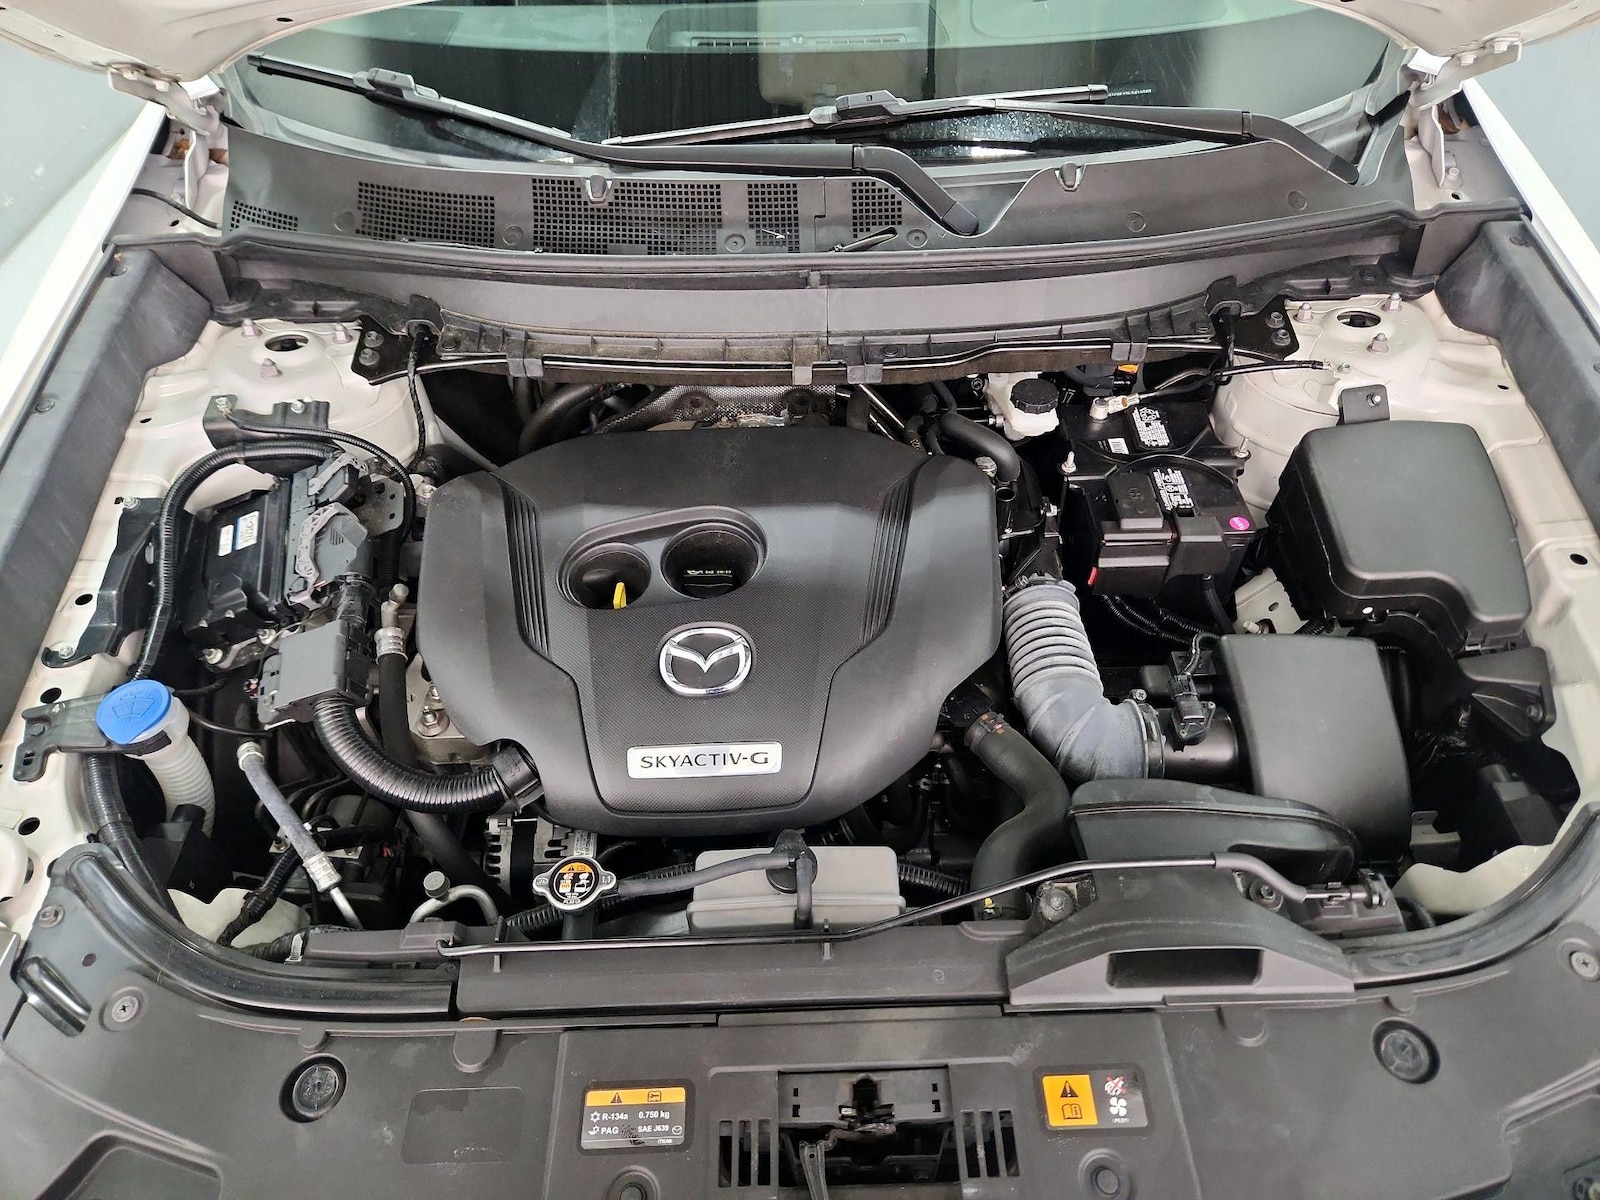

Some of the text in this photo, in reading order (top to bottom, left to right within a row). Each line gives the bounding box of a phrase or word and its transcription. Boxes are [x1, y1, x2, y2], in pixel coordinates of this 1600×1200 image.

[640, 752, 769, 769] SKYACTIV-G
[602, 1111, 629, 1121] R-134a
[638, 1110, 670, 1119] 0.750 kg
[601, 1127, 619, 1135] PAG
[637, 1124, 669, 1133] SAE J639
